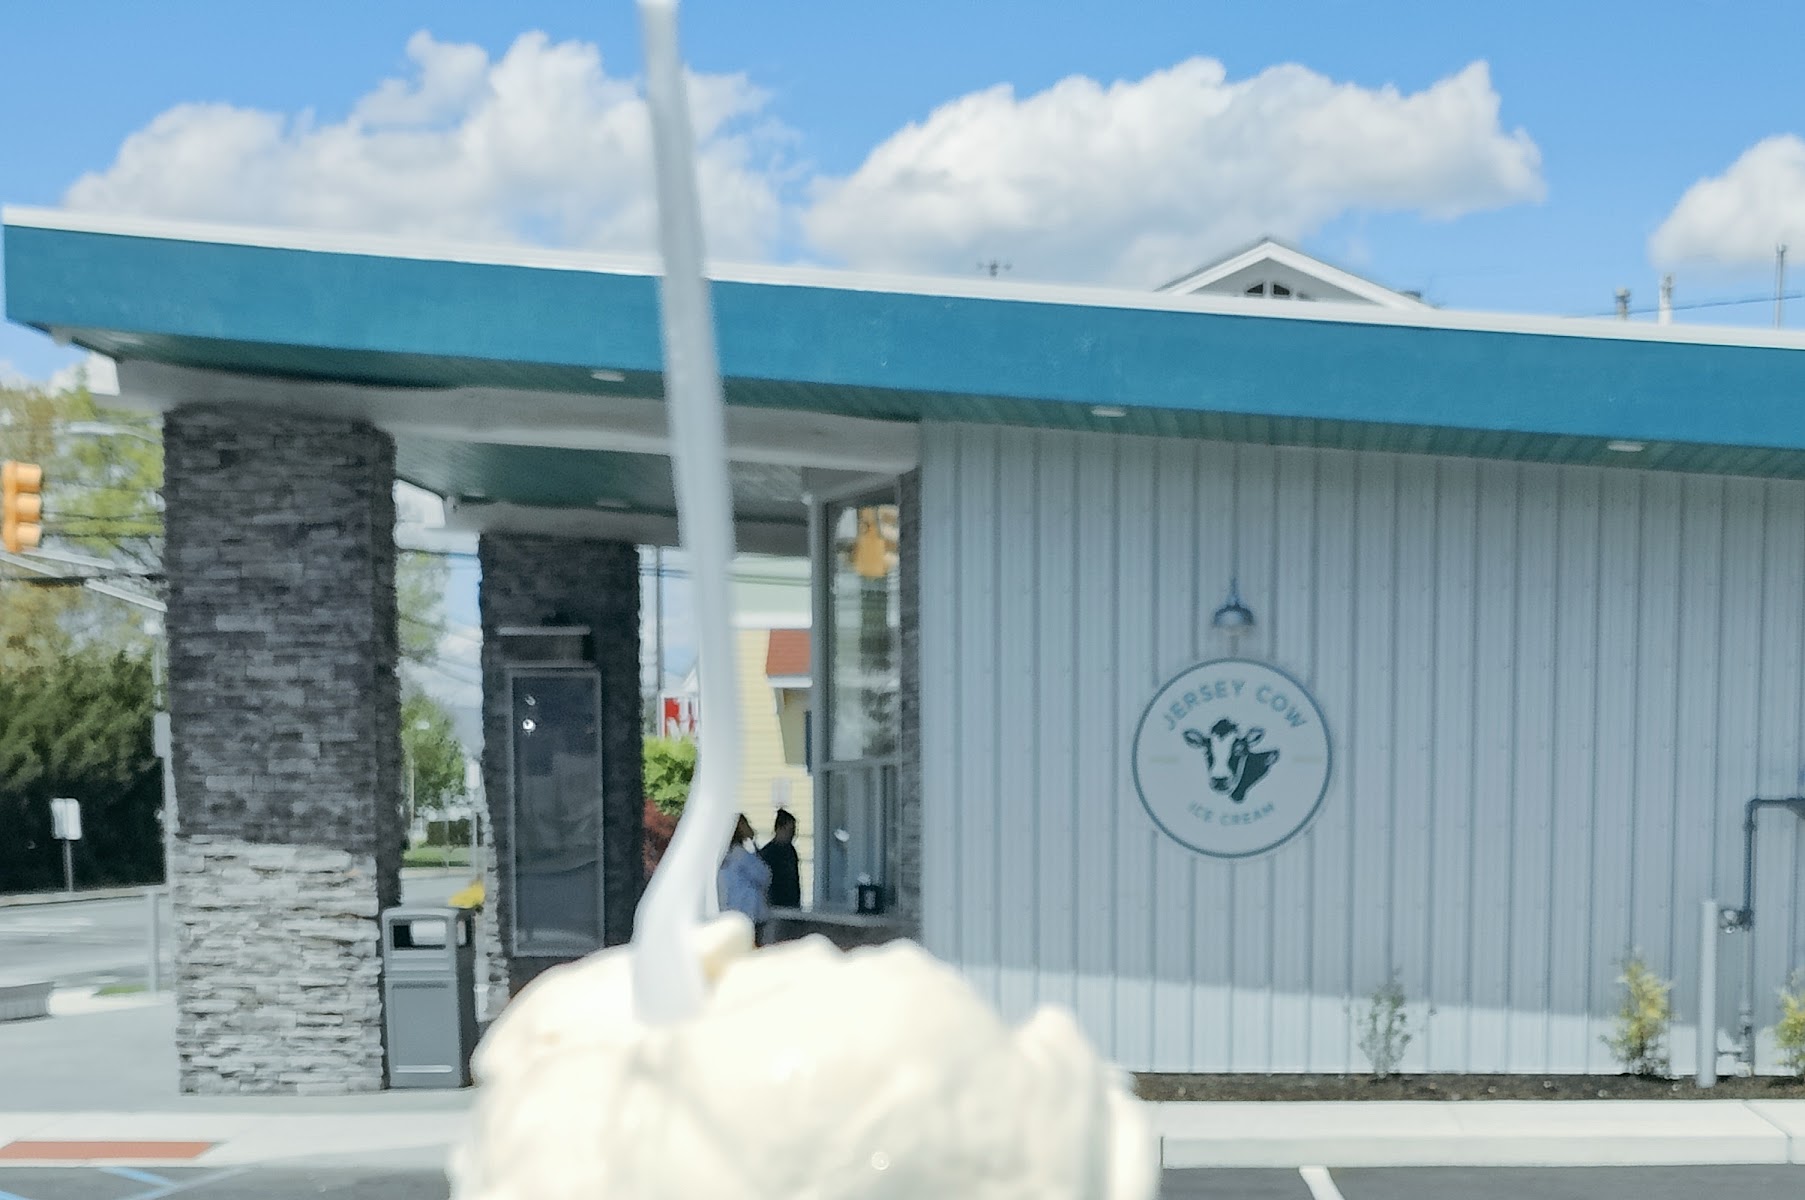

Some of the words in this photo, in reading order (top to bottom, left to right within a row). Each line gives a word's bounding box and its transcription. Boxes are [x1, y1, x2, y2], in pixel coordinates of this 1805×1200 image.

[1164, 681, 1245, 731] JERSEY
[1255, 684, 1306, 727] COW
[1189, 801, 1214, 823] ICE
[1219, 802, 1275, 825] CREAM
